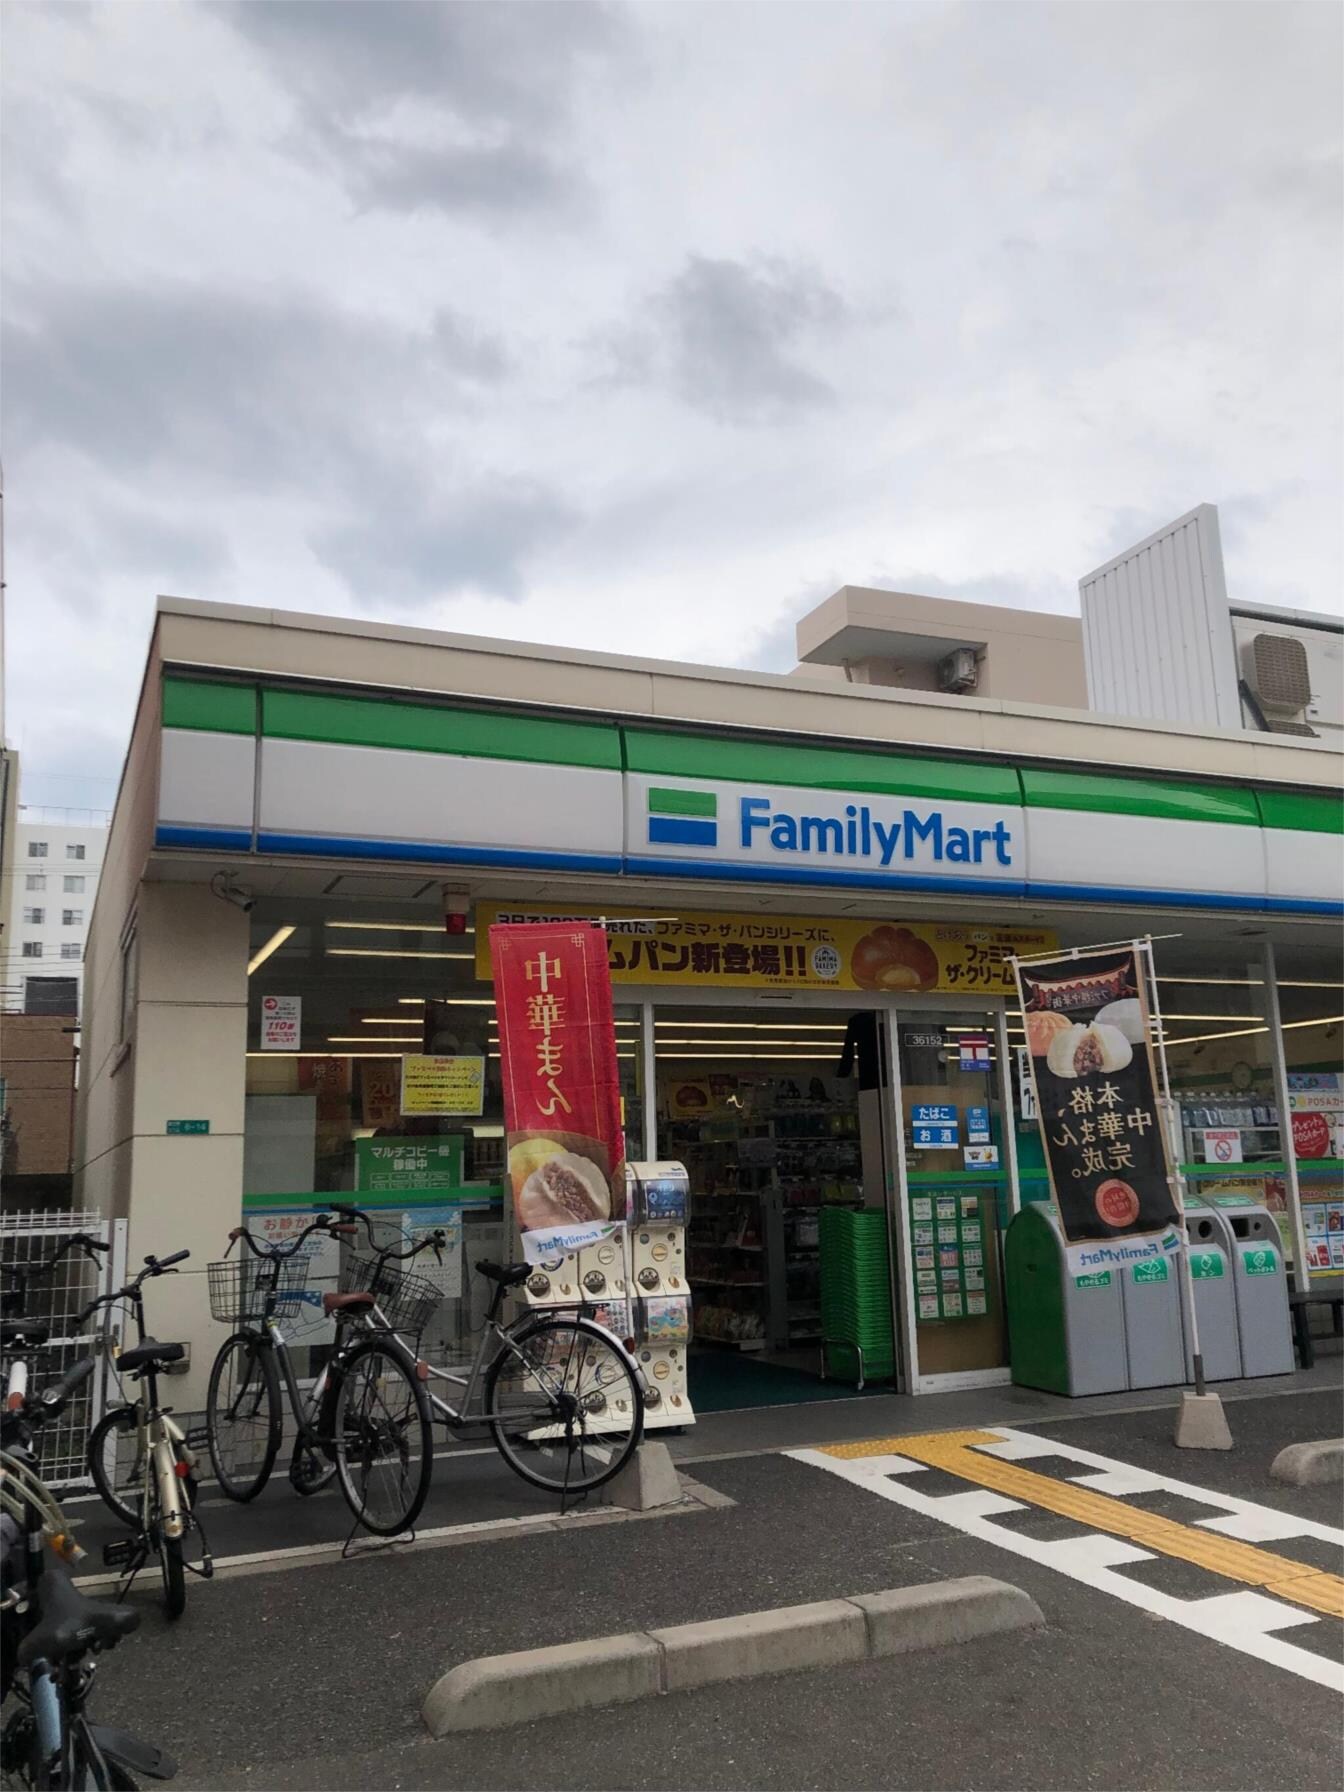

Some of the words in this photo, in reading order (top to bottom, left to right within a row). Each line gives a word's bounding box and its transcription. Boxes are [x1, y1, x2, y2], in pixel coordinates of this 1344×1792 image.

[739, 796, 1012, 867] FamilyMart
[814, 955, 839, 963] FAMIMA
[814, 962, 839, 970] BAKERY
[525, 951, 572, 1116] 中華まん
[912, 1036, 943, 1046] 36152
[919, 1107, 950, 1120] たばこ
[370, 1144, 450, 1159] マルチコピー機
